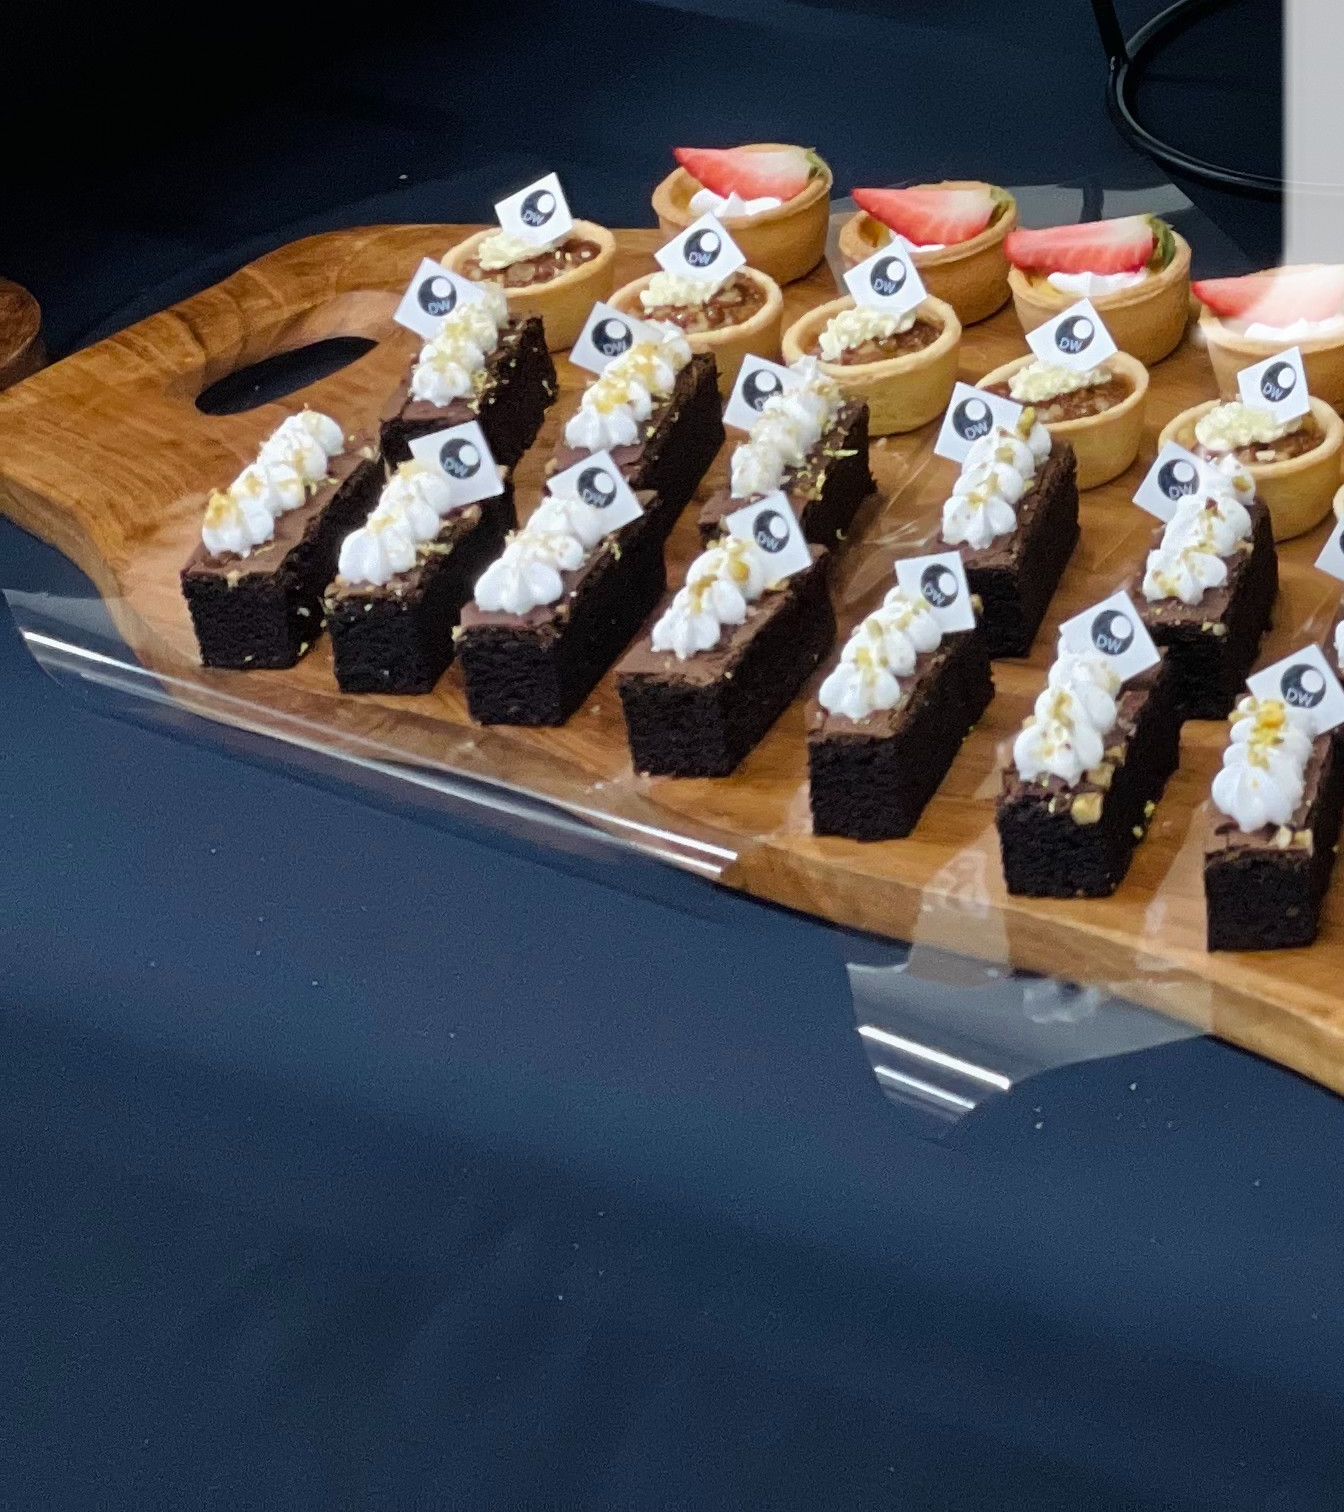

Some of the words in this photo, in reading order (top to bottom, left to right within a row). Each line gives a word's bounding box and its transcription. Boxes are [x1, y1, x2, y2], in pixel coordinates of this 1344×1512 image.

[524, 210, 544, 225] DW
[688, 251, 711, 264] DW
[874, 278, 896, 294] DW
[428, 299, 450, 314] DW
[1059, 337, 1082, 352] DW
[1262, 382, 1283, 400] DW
[964, 422, 988, 439] DW
[1097, 634, 1121, 652] DW
[1286, 687, 1312, 706] DW
